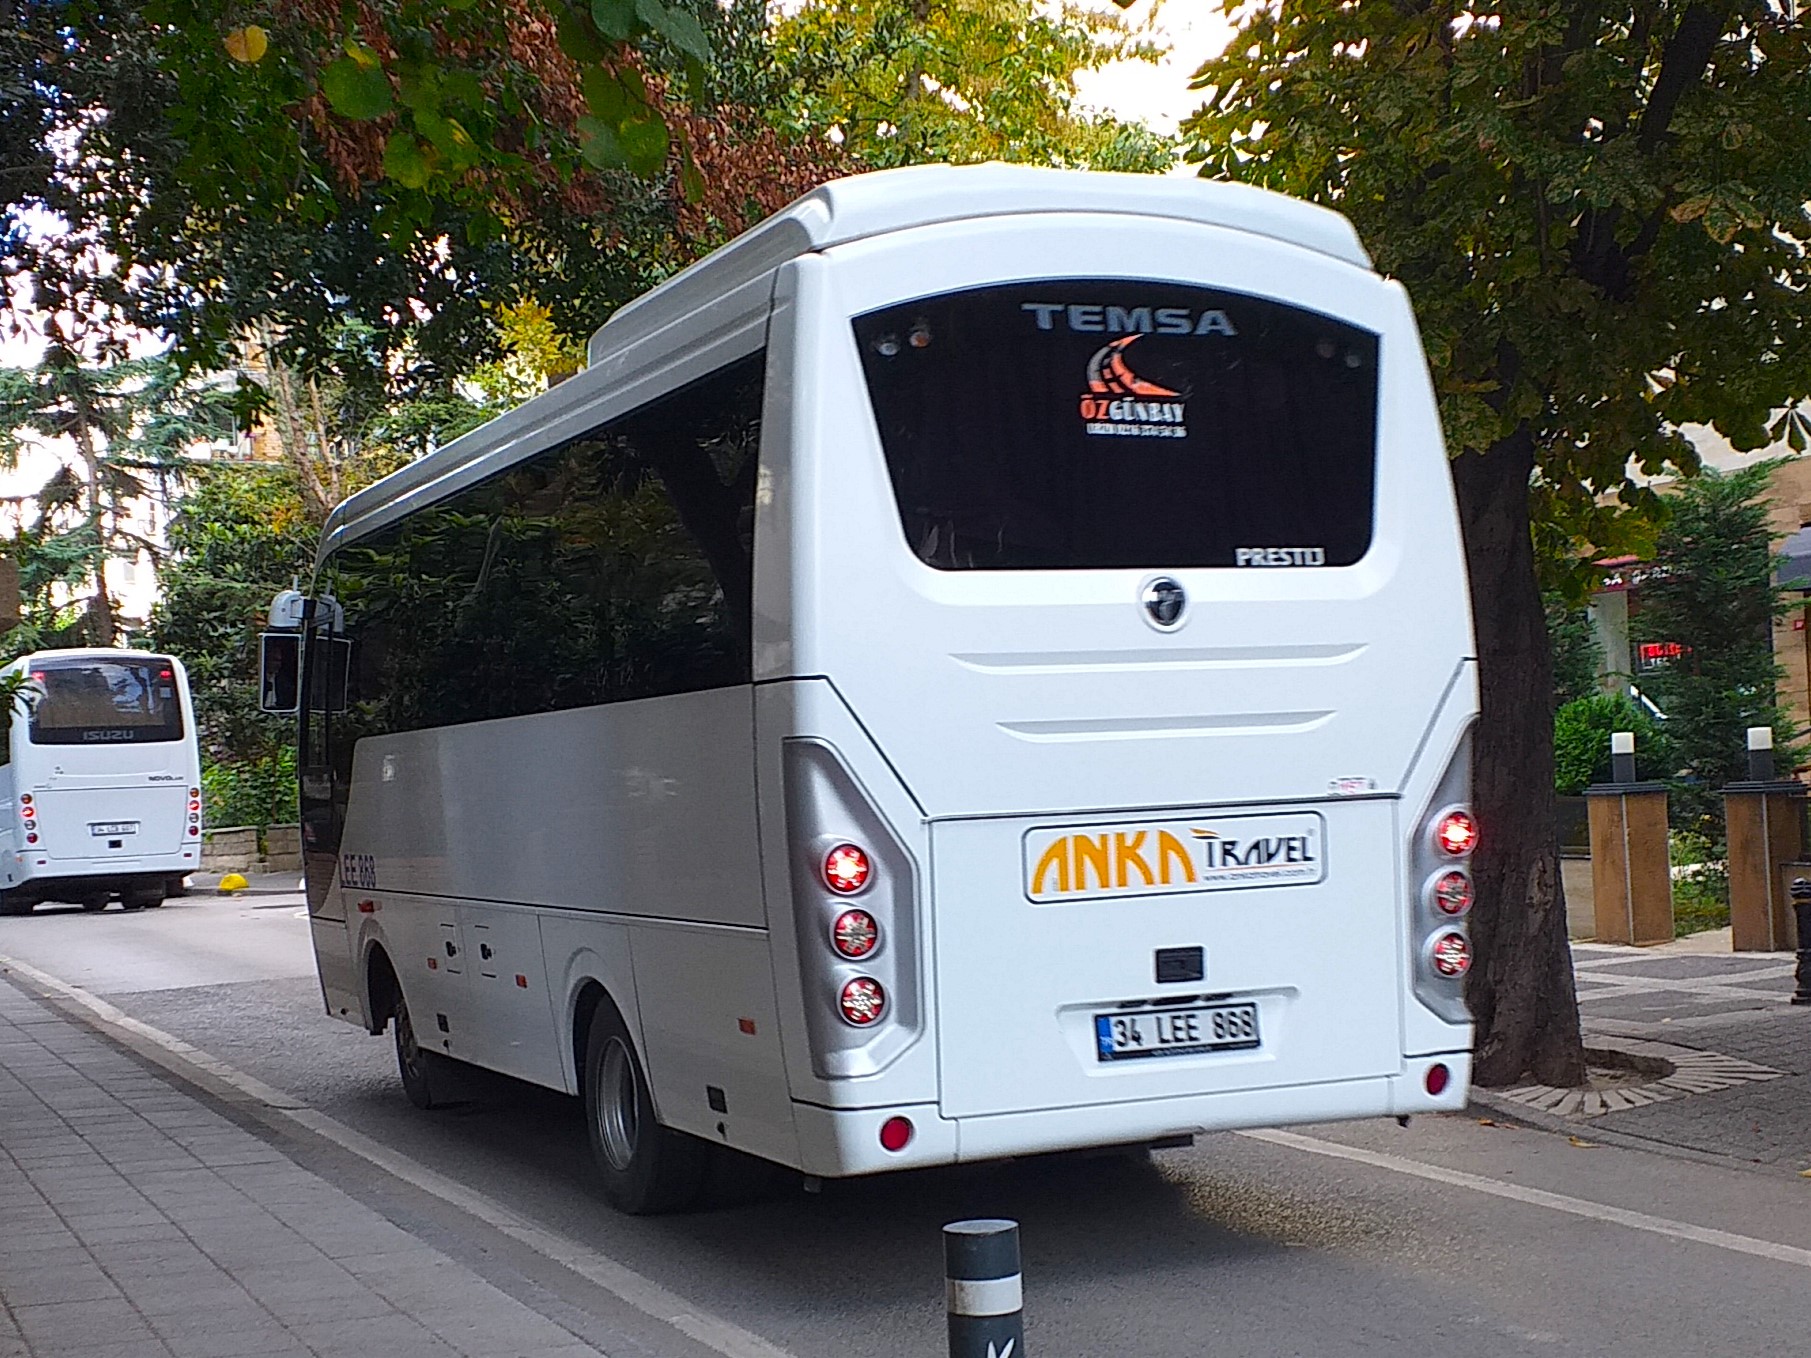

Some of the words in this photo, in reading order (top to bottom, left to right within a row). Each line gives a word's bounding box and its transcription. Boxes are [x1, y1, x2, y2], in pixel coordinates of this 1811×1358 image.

[1021, 302, 1239, 336] TEMSA
[1235, 547, 1326, 566] PRESTO
[83, 729, 135, 741] ISUZU
[359, 855, 377, 888] 868
[1031, 830, 1196, 894] ANKA
[1200, 834, 1316, 868] TRAVEL
[1114, 1017, 1143, 1048] 34
[1155, 1013, 1201, 1044] LEE
[1212, 1009, 1254, 1040] 868
